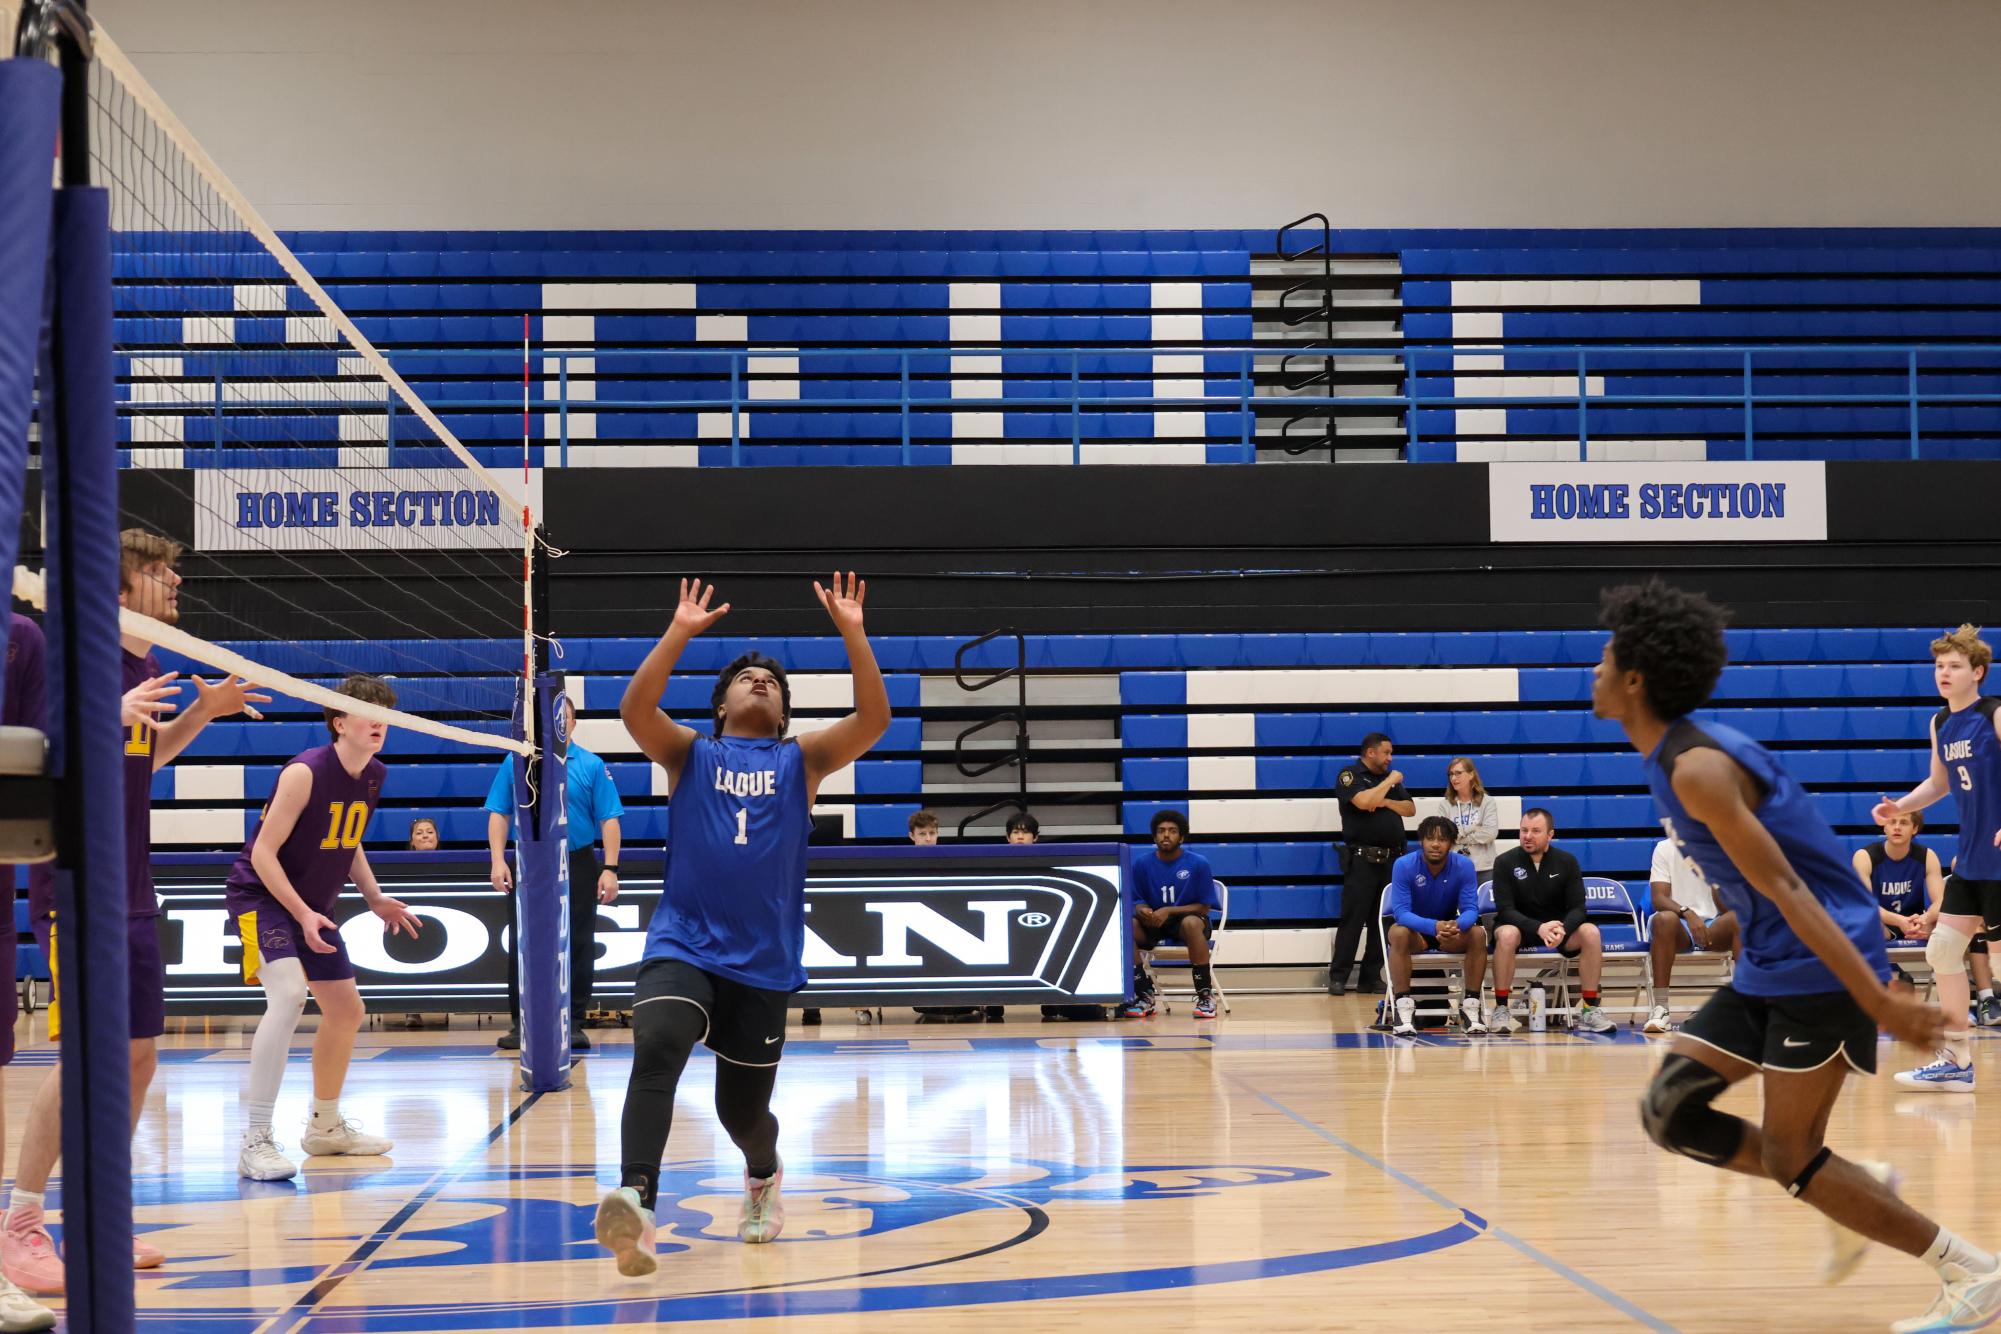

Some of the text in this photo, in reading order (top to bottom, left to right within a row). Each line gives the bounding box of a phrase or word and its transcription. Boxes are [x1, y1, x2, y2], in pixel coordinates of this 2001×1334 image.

[236, 489, 500, 529] HOME SECTION
[1530, 482, 1786, 520] HOME SECTION
[1943, 739, 1973, 762] LADUE
[715, 766, 776, 797] LADUE
[1957, 765, 1973, 791] 9
[320, 800, 369, 850] 10
[734, 807, 748, 845] 1
[1161, 885, 1175, 904] 11
[1585, 886, 1616, 899] DUE
[1881, 880, 1912, 895] LADUE
